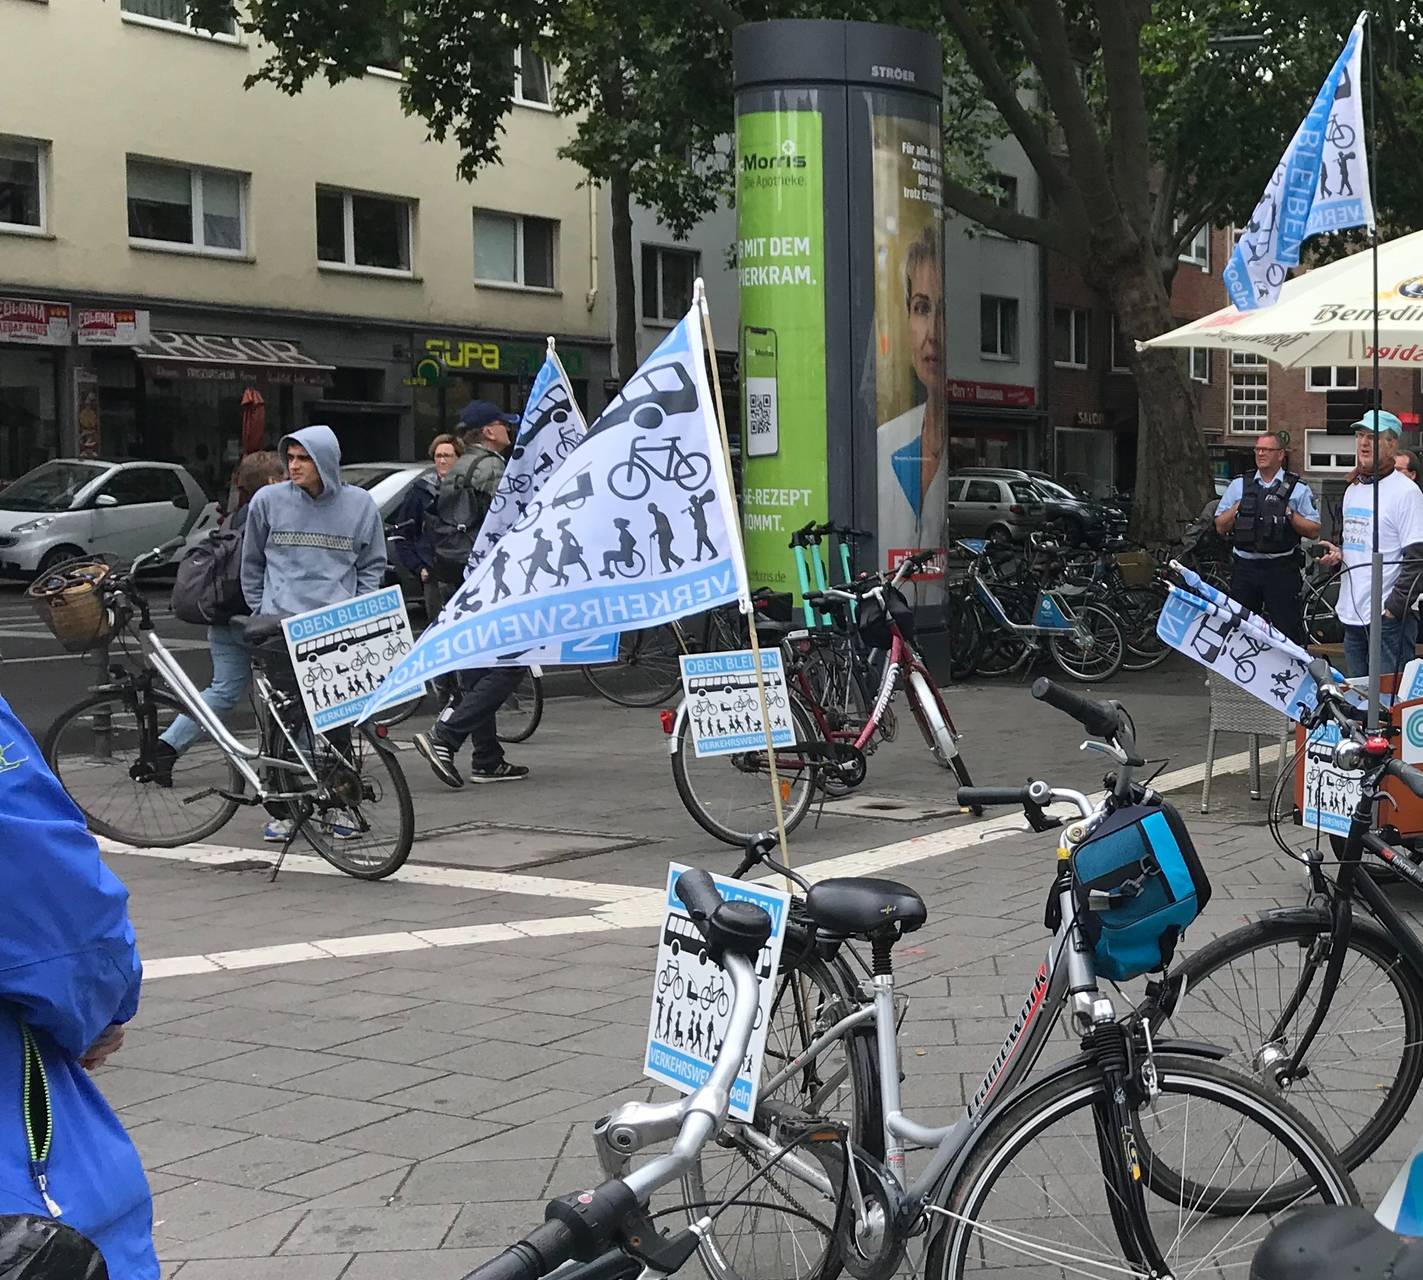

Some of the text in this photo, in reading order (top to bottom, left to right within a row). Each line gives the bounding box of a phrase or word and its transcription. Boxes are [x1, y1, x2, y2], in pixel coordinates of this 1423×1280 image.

[871, 64, 916, 82] STRÖER
[745, 237, 767, 259] MIT
[769, 236, 811, 257] DEM
[289, 590, 400, 640] OBEN BLEIBEN
[686, 653, 778, 674] OBEN BLEIEN
